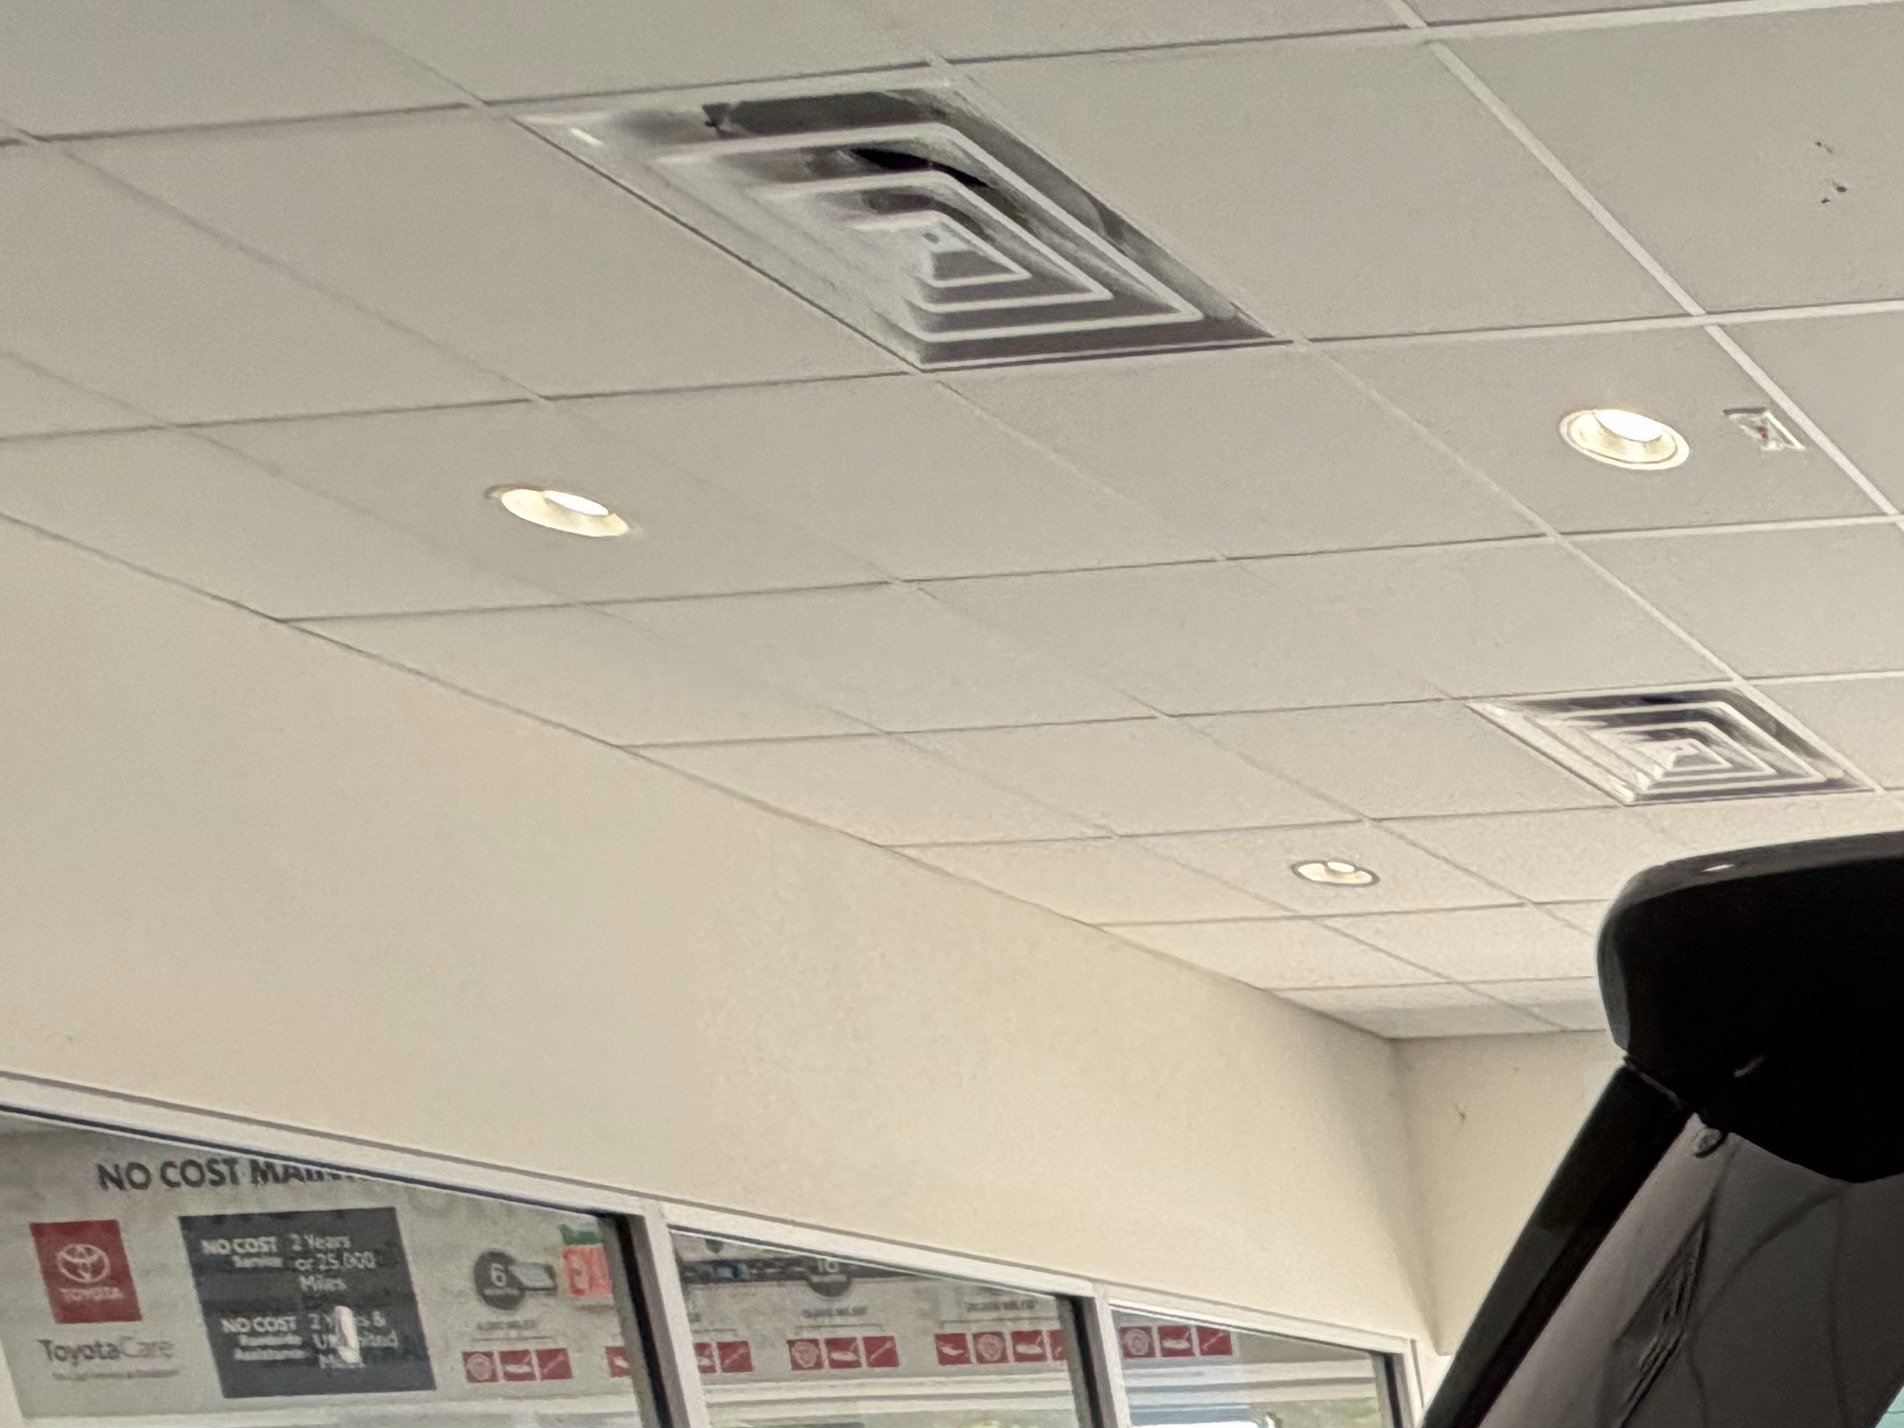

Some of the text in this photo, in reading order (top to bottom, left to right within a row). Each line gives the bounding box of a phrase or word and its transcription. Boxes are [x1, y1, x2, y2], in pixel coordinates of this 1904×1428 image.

[98, 1162, 153, 1193] NO
[160, 1158, 240, 1188] COST
[489, 1263, 507, 1288] 6
